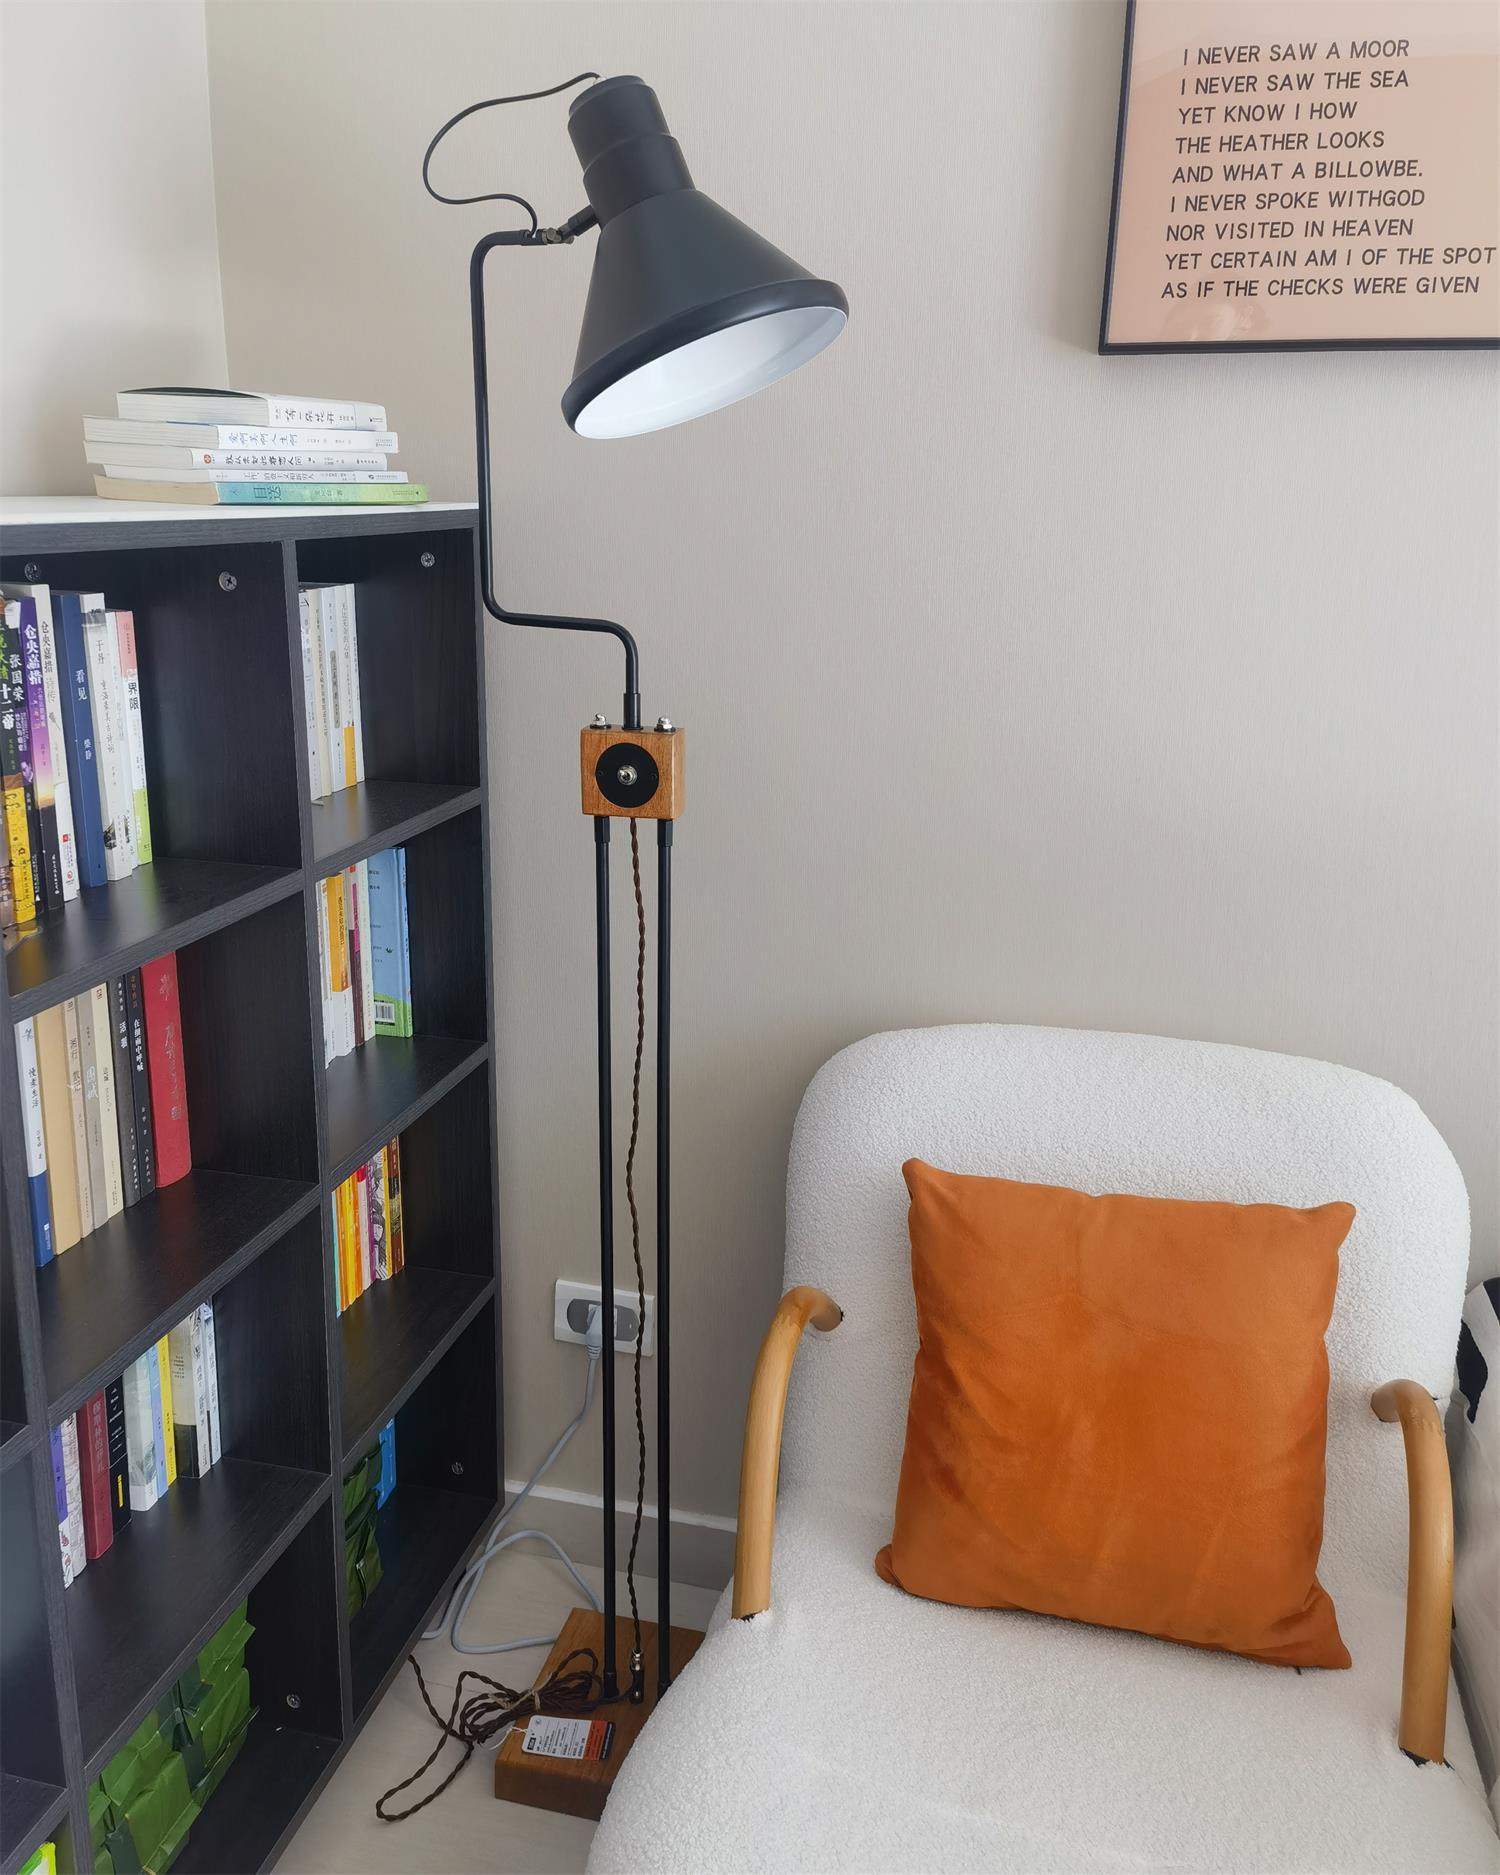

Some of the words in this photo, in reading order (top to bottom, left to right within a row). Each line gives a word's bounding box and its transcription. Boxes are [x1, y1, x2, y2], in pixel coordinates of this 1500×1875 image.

[1183, 48, 1189, 66] I
[1198, 45, 1260, 65] NEVER
[1270, 43, 1317, 61] SAW
[1325, 41, 1341, 60] A
[1350, 40, 1409, 58] MOOR
[1180, 78, 1186, 96] I
[1195, 76, 1257, 94] NEVER
[1267, 73, 1314, 91] SAW
[1324, 72, 1361, 89] THE
[1370, 70, 1408, 88] SEA
[1179, 107, 1216, 124] YET
[1224, 104, 1285, 123] KNOW
[1294, 102, 1301, 121] I
[1310, 101, 1357, 120] HOW
[1176, 136, 1211, 154] THE
[1219, 133, 1308, 152] HEATHER
[1317, 131, 1384, 149] LOOKS
[1172, 166, 1213, 183] AND
[1223, 163, 1283, 181] WHAT
[1290, 161, 1306, 180] A
[1315, 160, 1423, 178] BILLOWBE.
[1170, 195, 1176, 213] I
[1185, 194, 1246, 212] NEVER
[1256, 192, 1319, 209] SPOKE
[1329, 189, 1425, 207] WITHGOD
[1166, 224, 1205, 241] NOR
[1215, 222, 1294, 240] VISITED
[1305, 221, 1324, 237] IN
[1332, 219, 1413, 237] HEAVEN
[1165, 253, 1202, 270] YET
[1211, 250, 1296, 269] CERTAIN
[1304, 249, 1337, 266] AM
[1346, 248, 1352, 266] I
[1362, 249, 1387, 265] OF
[1397, 248, 1434, 264] THE
[1443, 247, 1496, 264] SPOT
[1161, 282, 1187, 298] AS
[1197, 281, 1215, 298] IF
[1224, 280, 1259, 297] THE
[1268, 278, 1343, 296] CHECKS
[1354, 277, 1407, 294] WERE
[1416, 276, 1479, 293] GIVEN
[254, 484, 281, 501] 目送
[24, 624, 42, 685] 仓央嘉措
[9, 654, 25, 702] 张国荣
[75, 669, 88, 701] 看见
